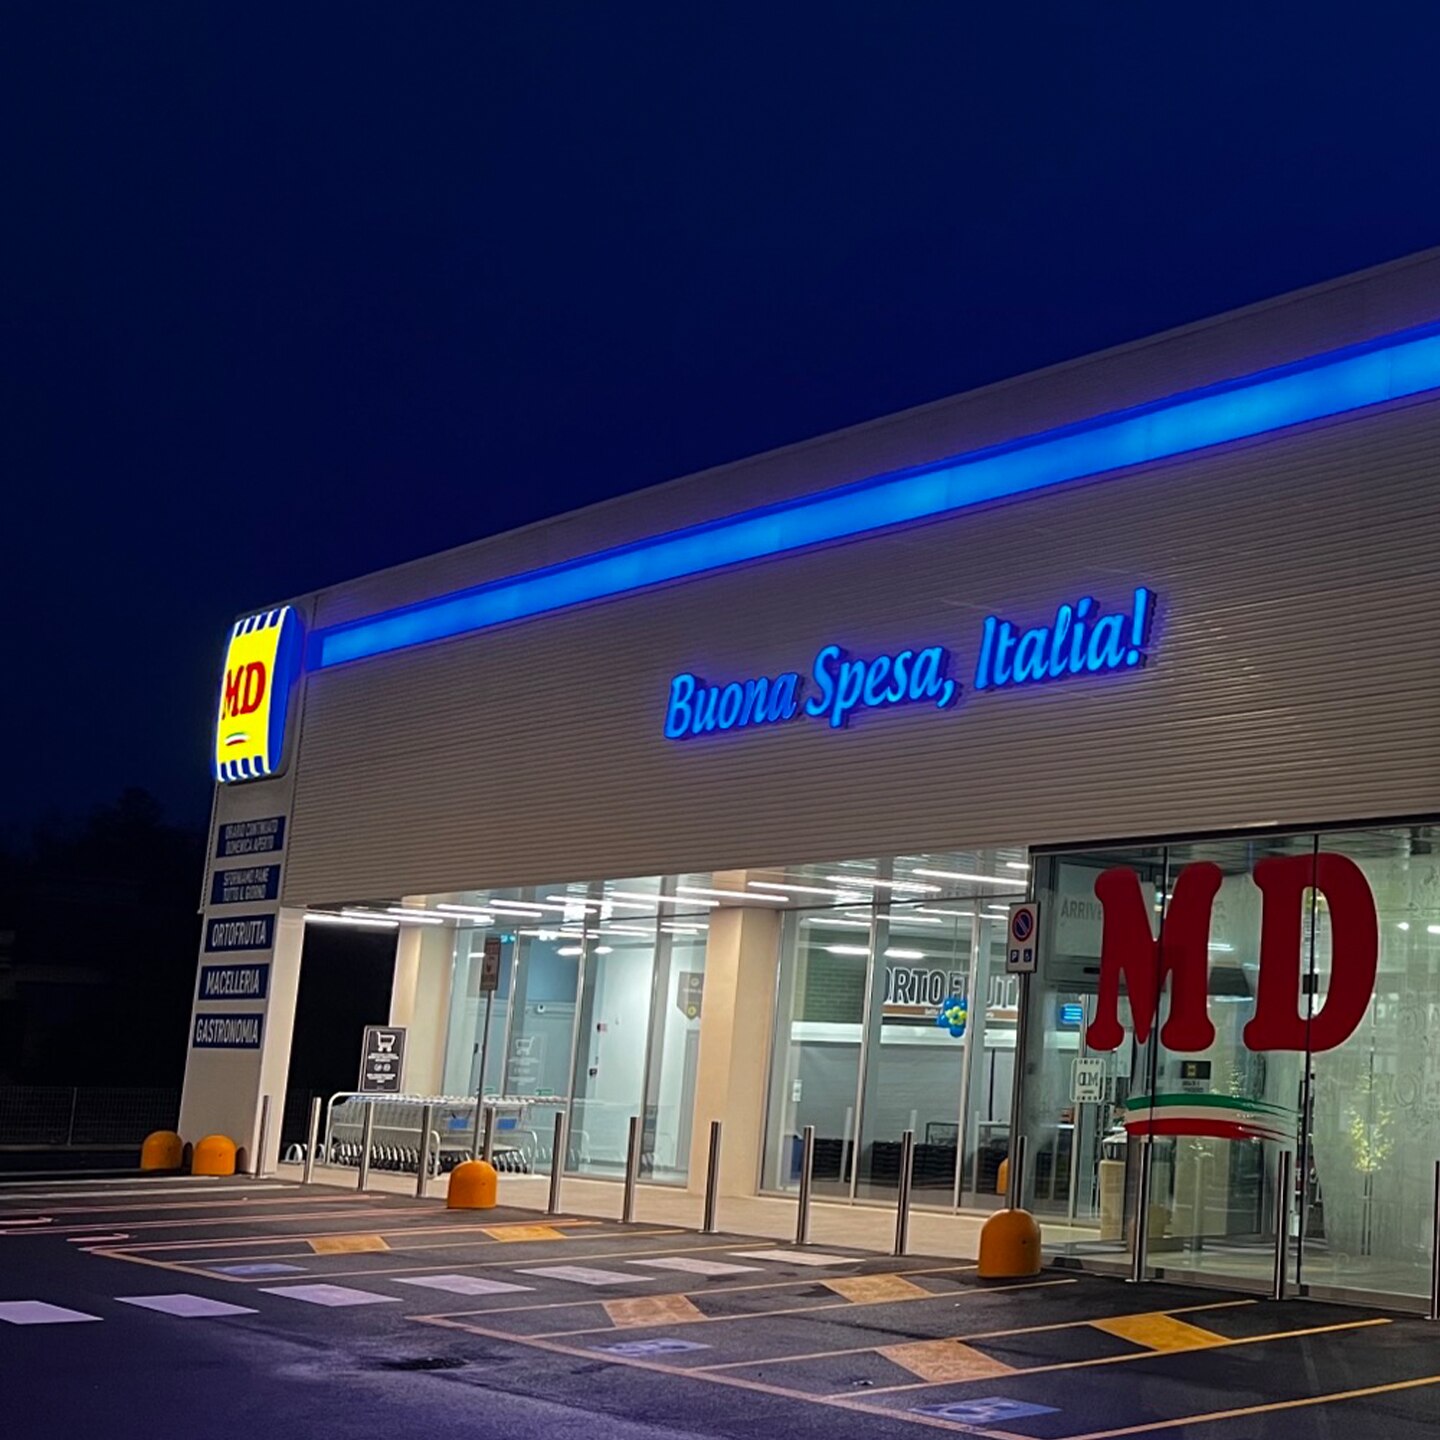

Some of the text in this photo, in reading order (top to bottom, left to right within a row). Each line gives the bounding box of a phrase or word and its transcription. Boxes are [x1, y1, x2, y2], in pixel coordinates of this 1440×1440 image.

[664, 587, 1150, 740] Buona Spesa, Italia!
[221, 660, 267, 721] MD
[211, 920, 268, 947] ORTOFRUTTA
[1085, 852, 1379, 1053] MD
[204, 969, 261, 995] MACELLERIA
[195, 1018, 259, 1044] GASTRONOMIA
